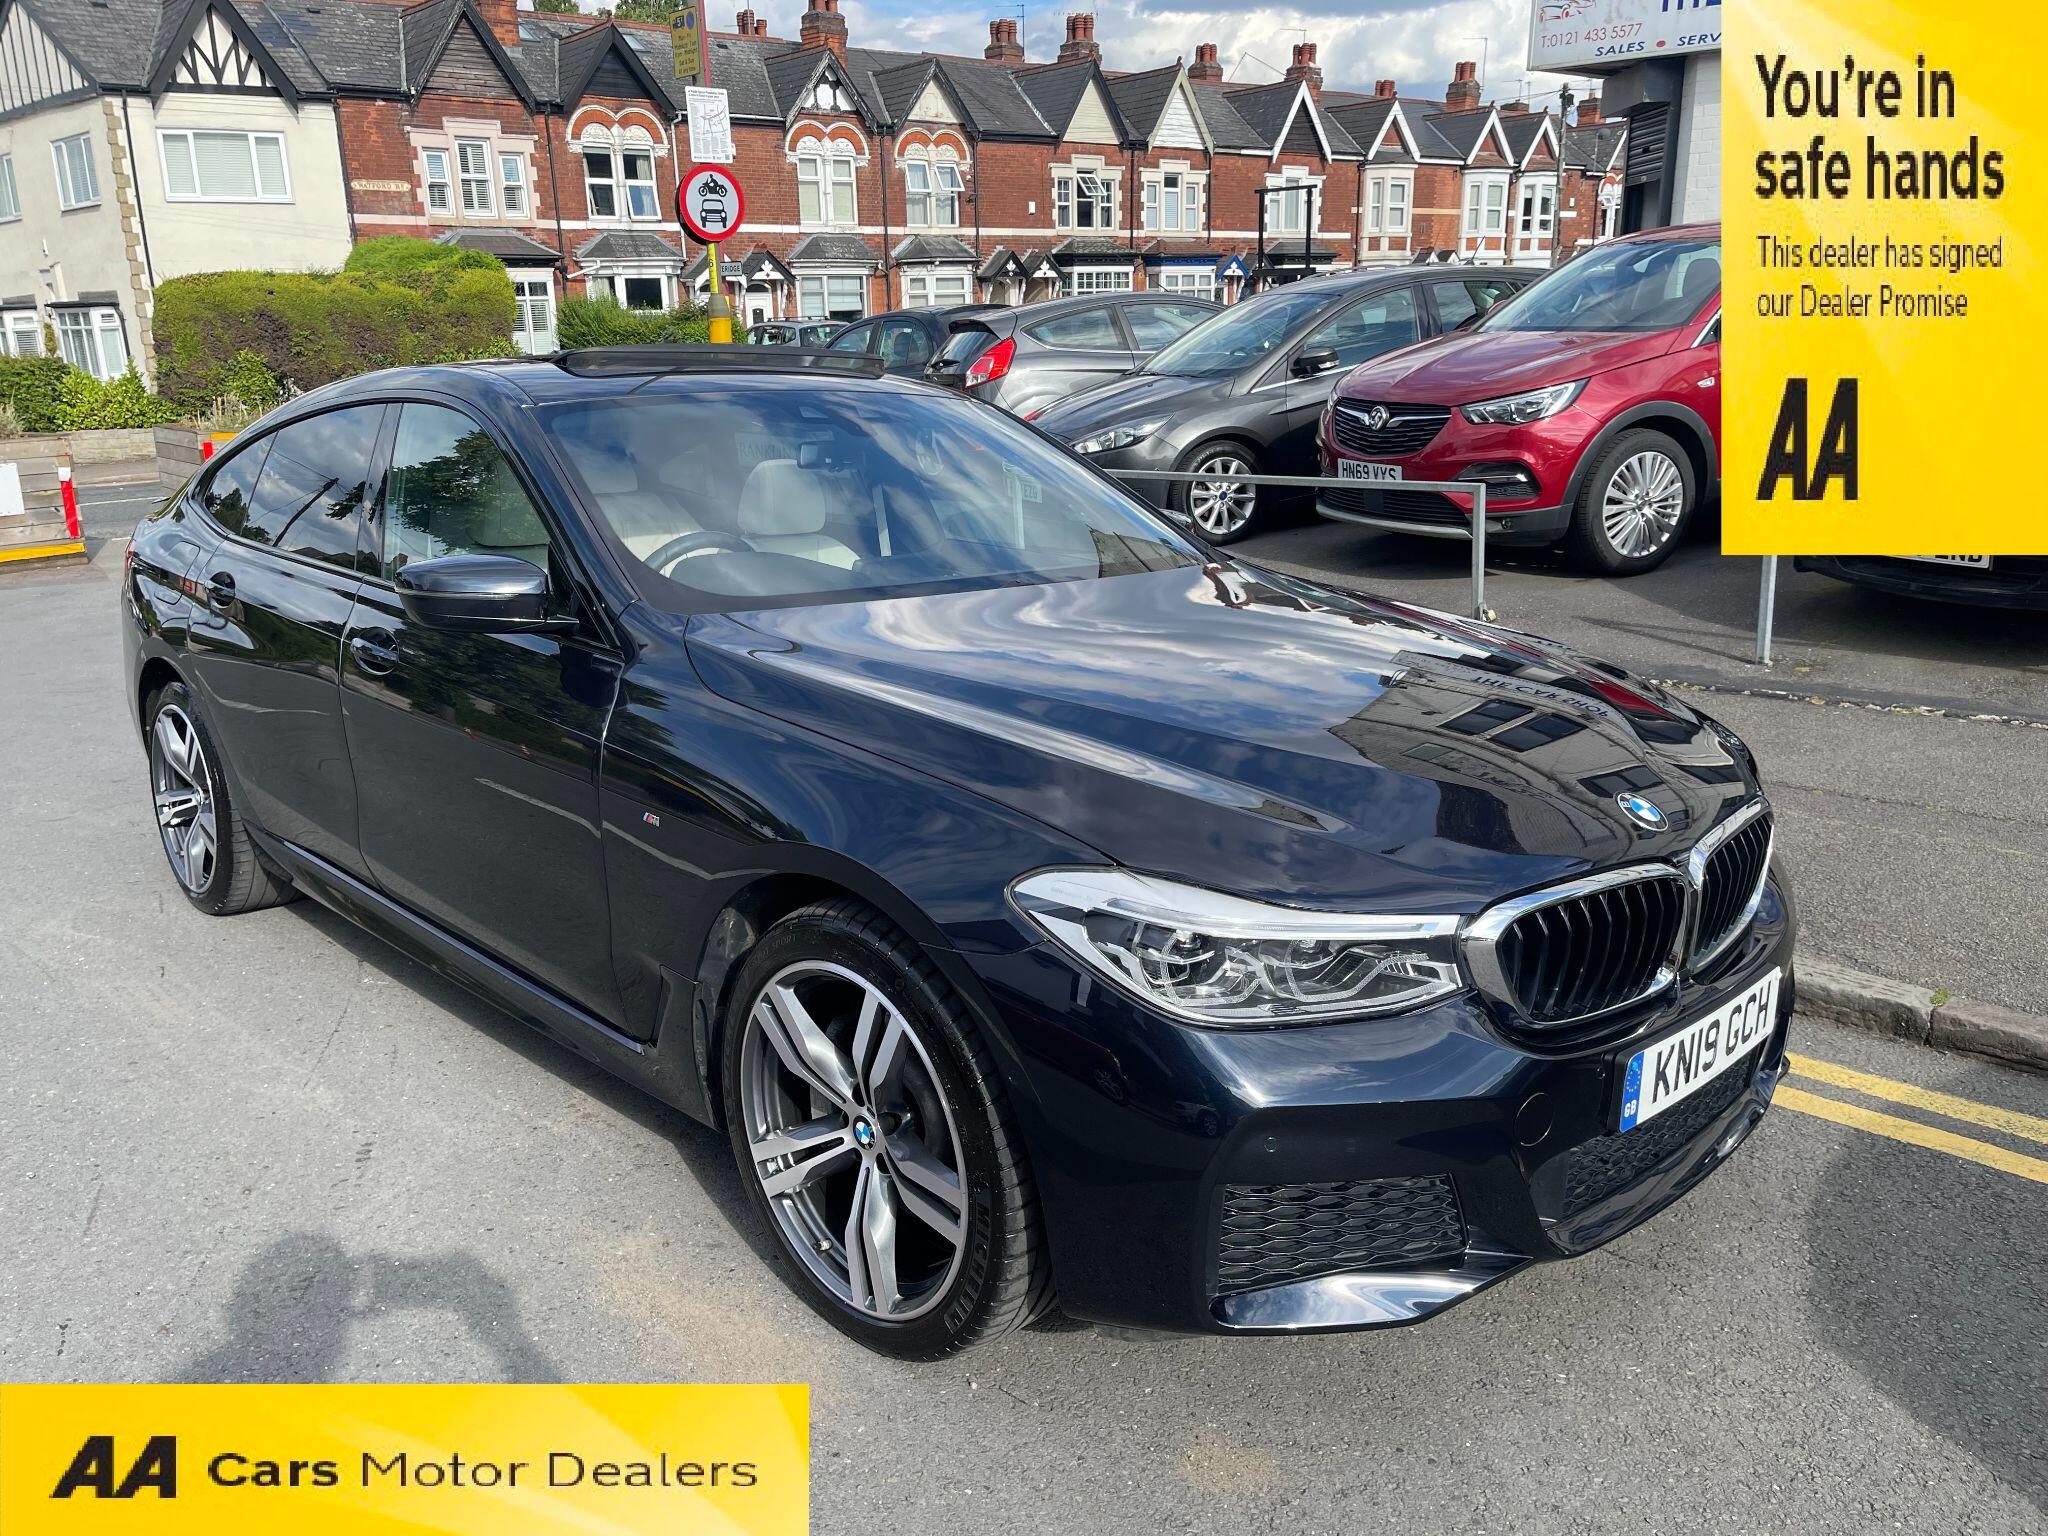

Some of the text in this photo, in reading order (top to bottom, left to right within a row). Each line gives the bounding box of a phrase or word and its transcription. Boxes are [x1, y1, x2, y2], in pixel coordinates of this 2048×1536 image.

[1540, 23, 1642, 48] T:0121 433 5577
[1595, 41, 1645, 57] SALES
[1342, 462, 1369, 480] HN69
[1651, 980, 1771, 1105] KN19 GCH
[1624, 1099, 1637, 1118] GB
